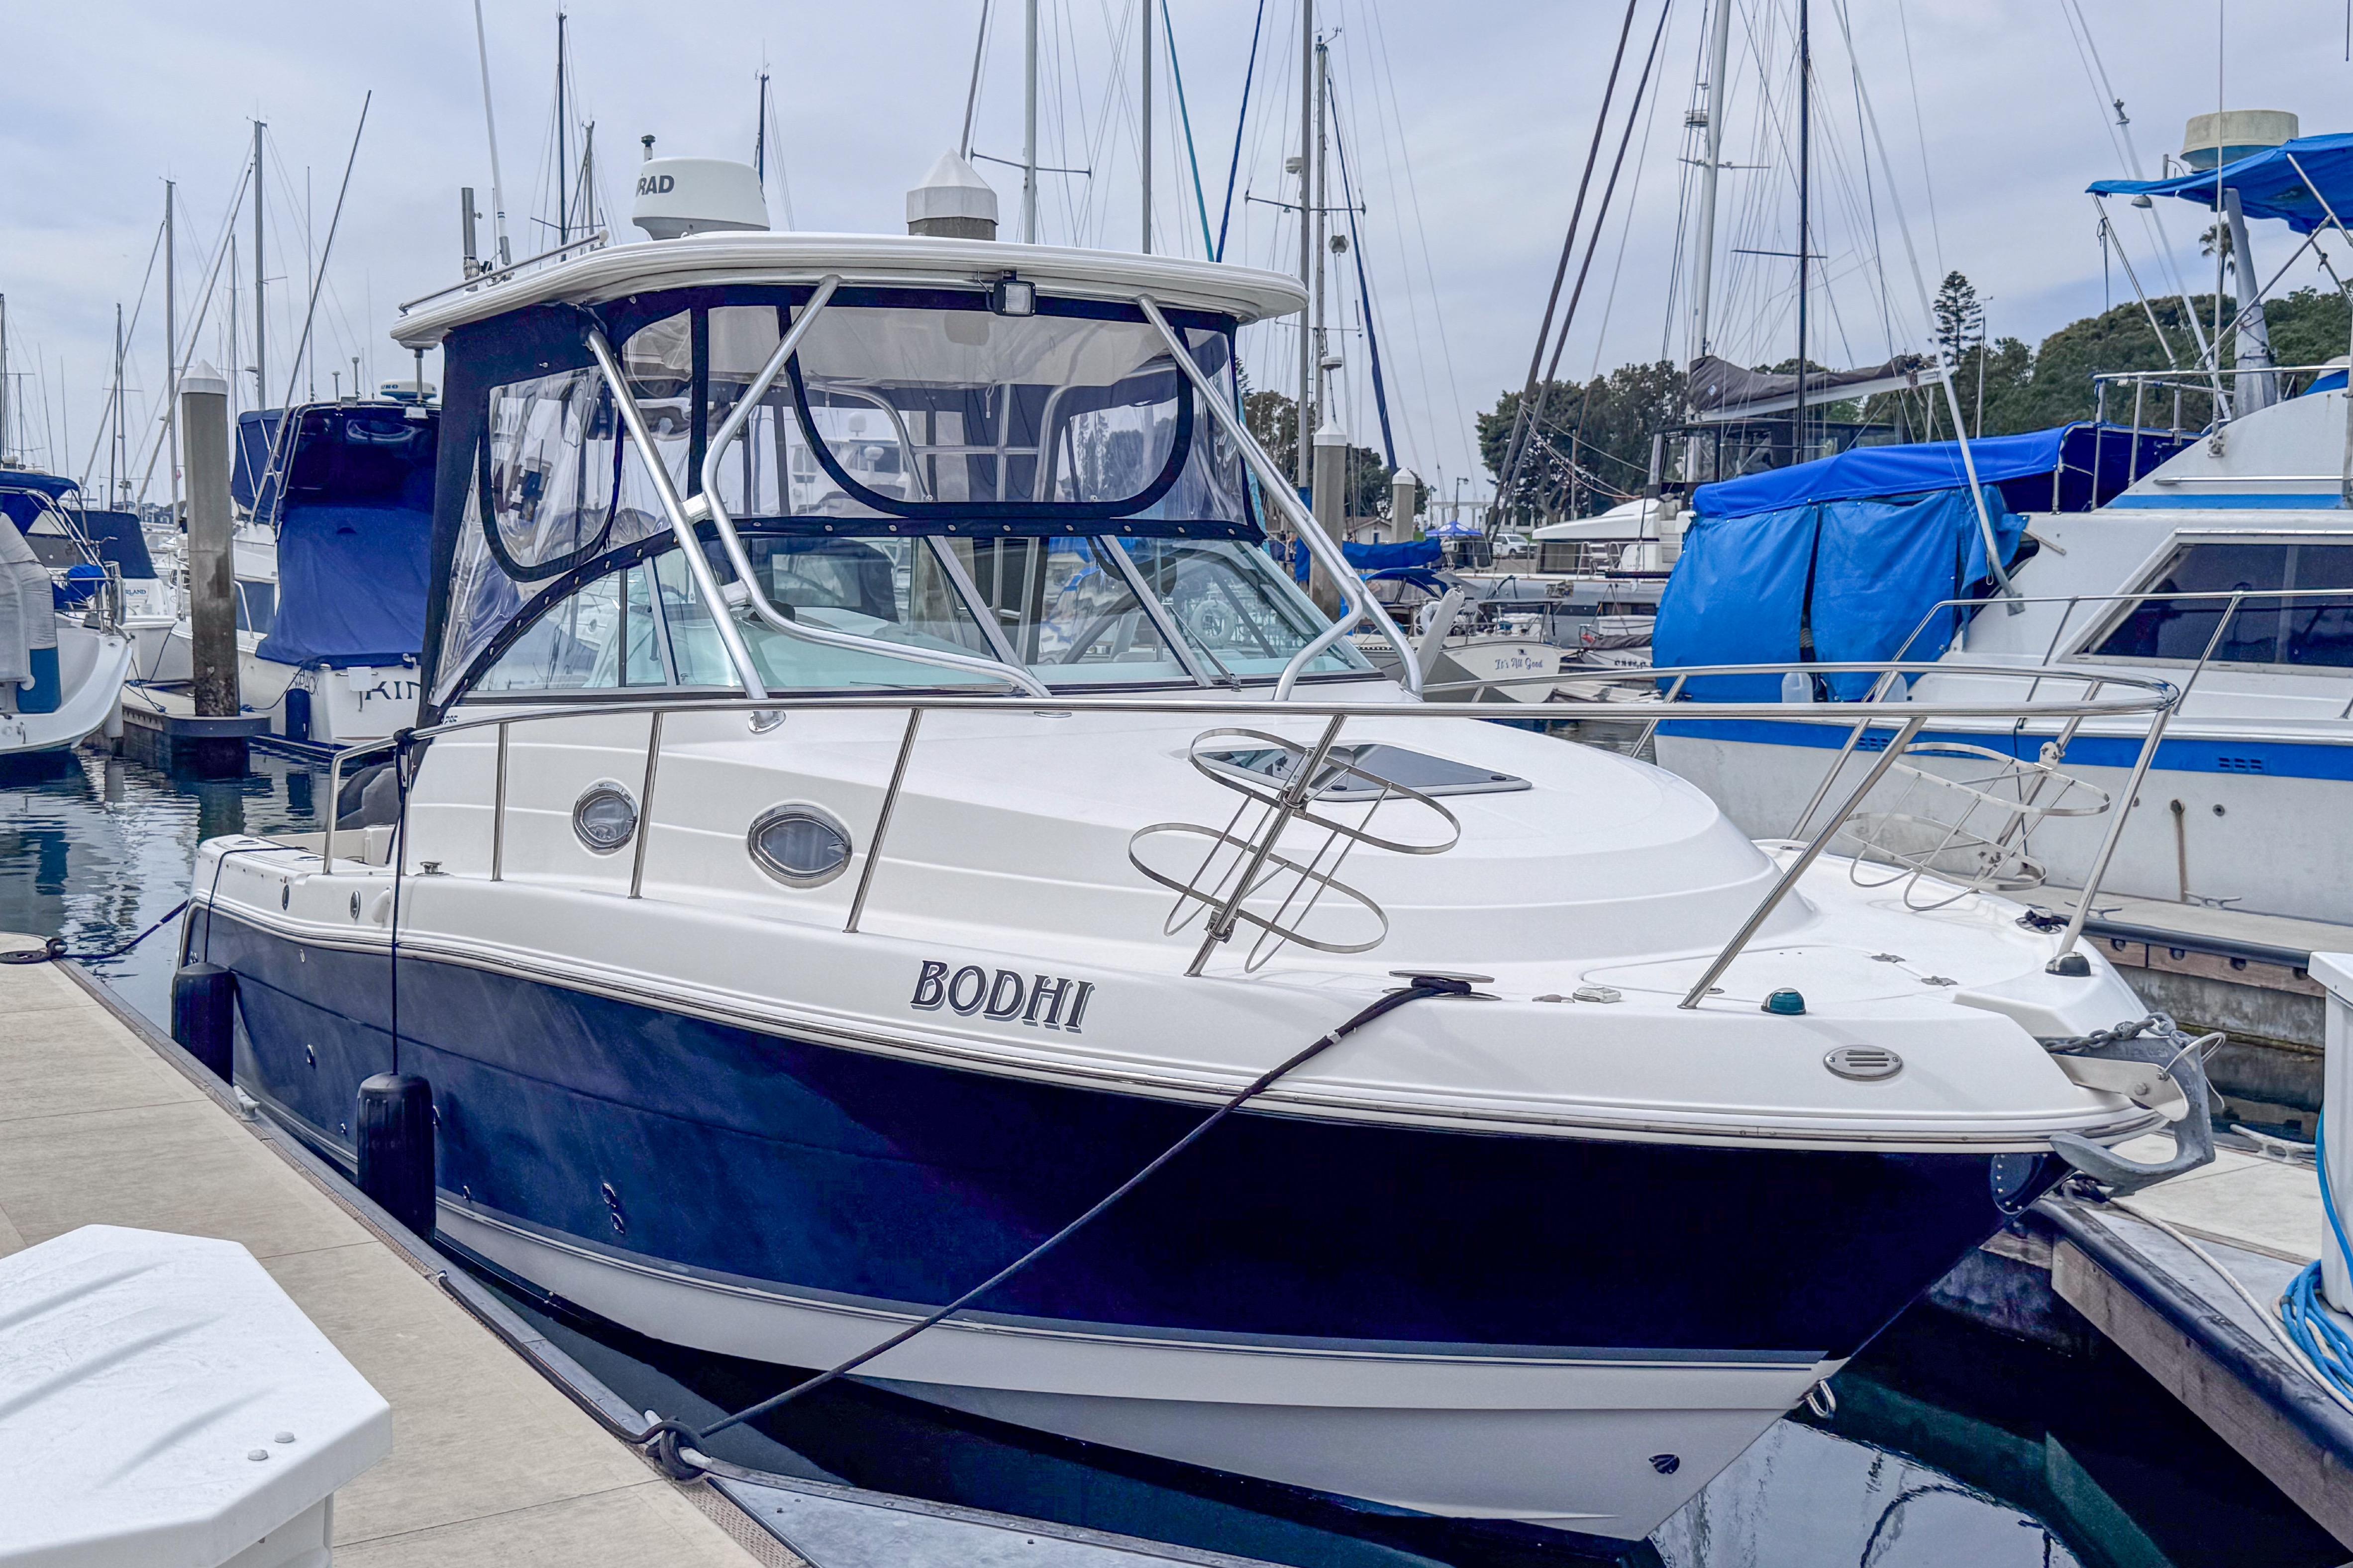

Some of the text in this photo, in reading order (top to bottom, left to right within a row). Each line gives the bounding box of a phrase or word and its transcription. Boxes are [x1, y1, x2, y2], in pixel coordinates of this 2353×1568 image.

[635, 175, 675, 197] RAD
[1495, 657, 1543, 670] It's All Good
[910, 960, 1096, 1034] BODHI
